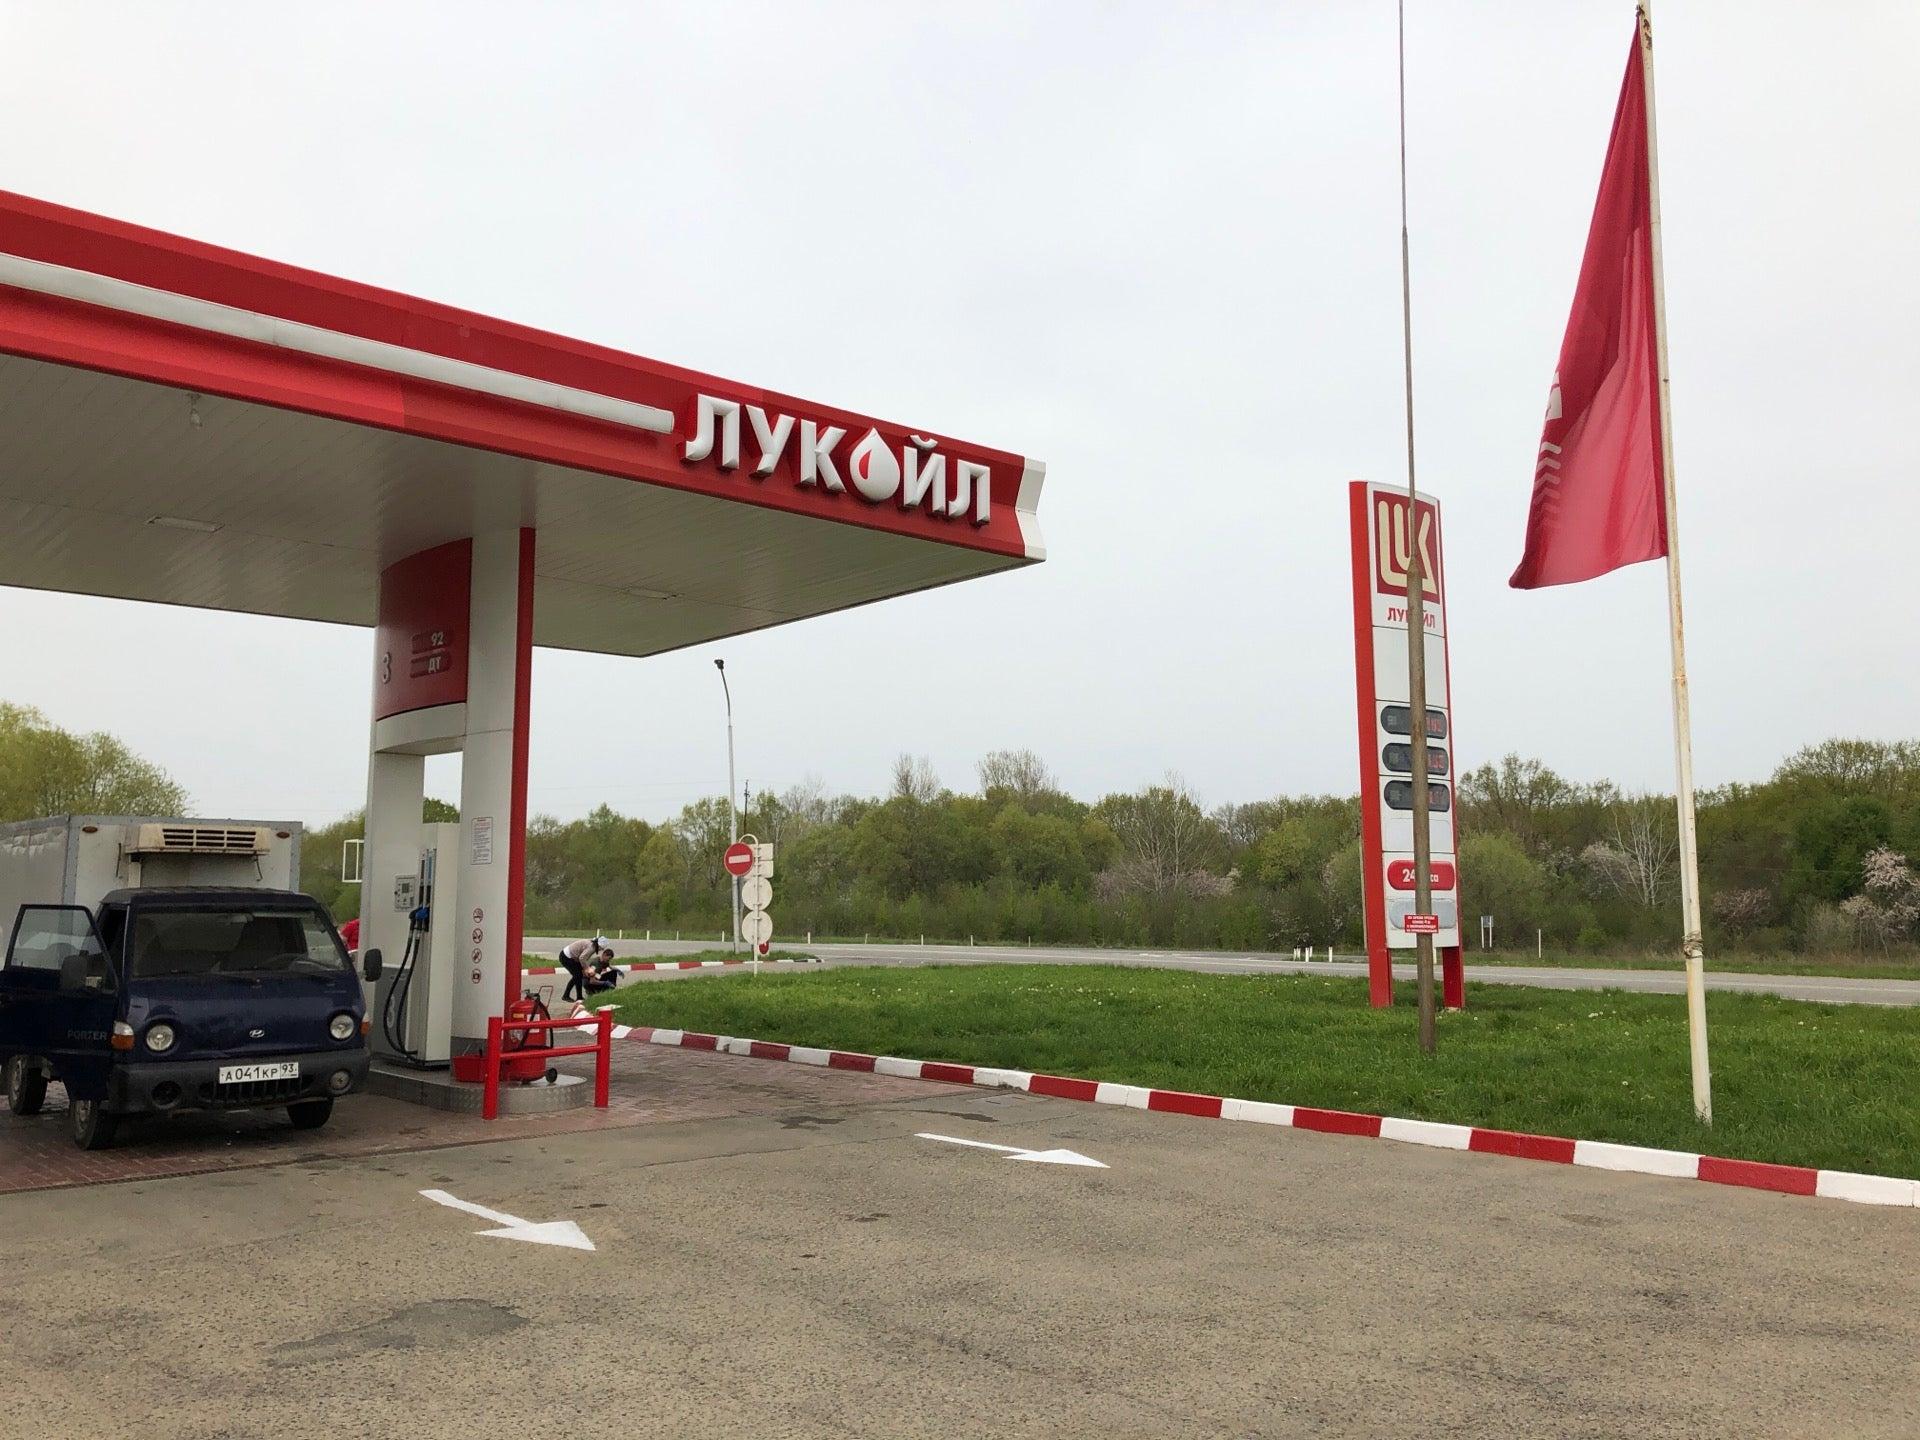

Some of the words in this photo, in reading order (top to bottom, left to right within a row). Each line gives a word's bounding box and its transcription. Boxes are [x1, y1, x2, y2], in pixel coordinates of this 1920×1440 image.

[431, 631, 444, 646] 92
[382, 651, 392, 685] 3
[427, 656, 442, 674] ДТ
[67, 1030, 108, 1041] PORTER
[282, 1064, 294, 1073] 93
